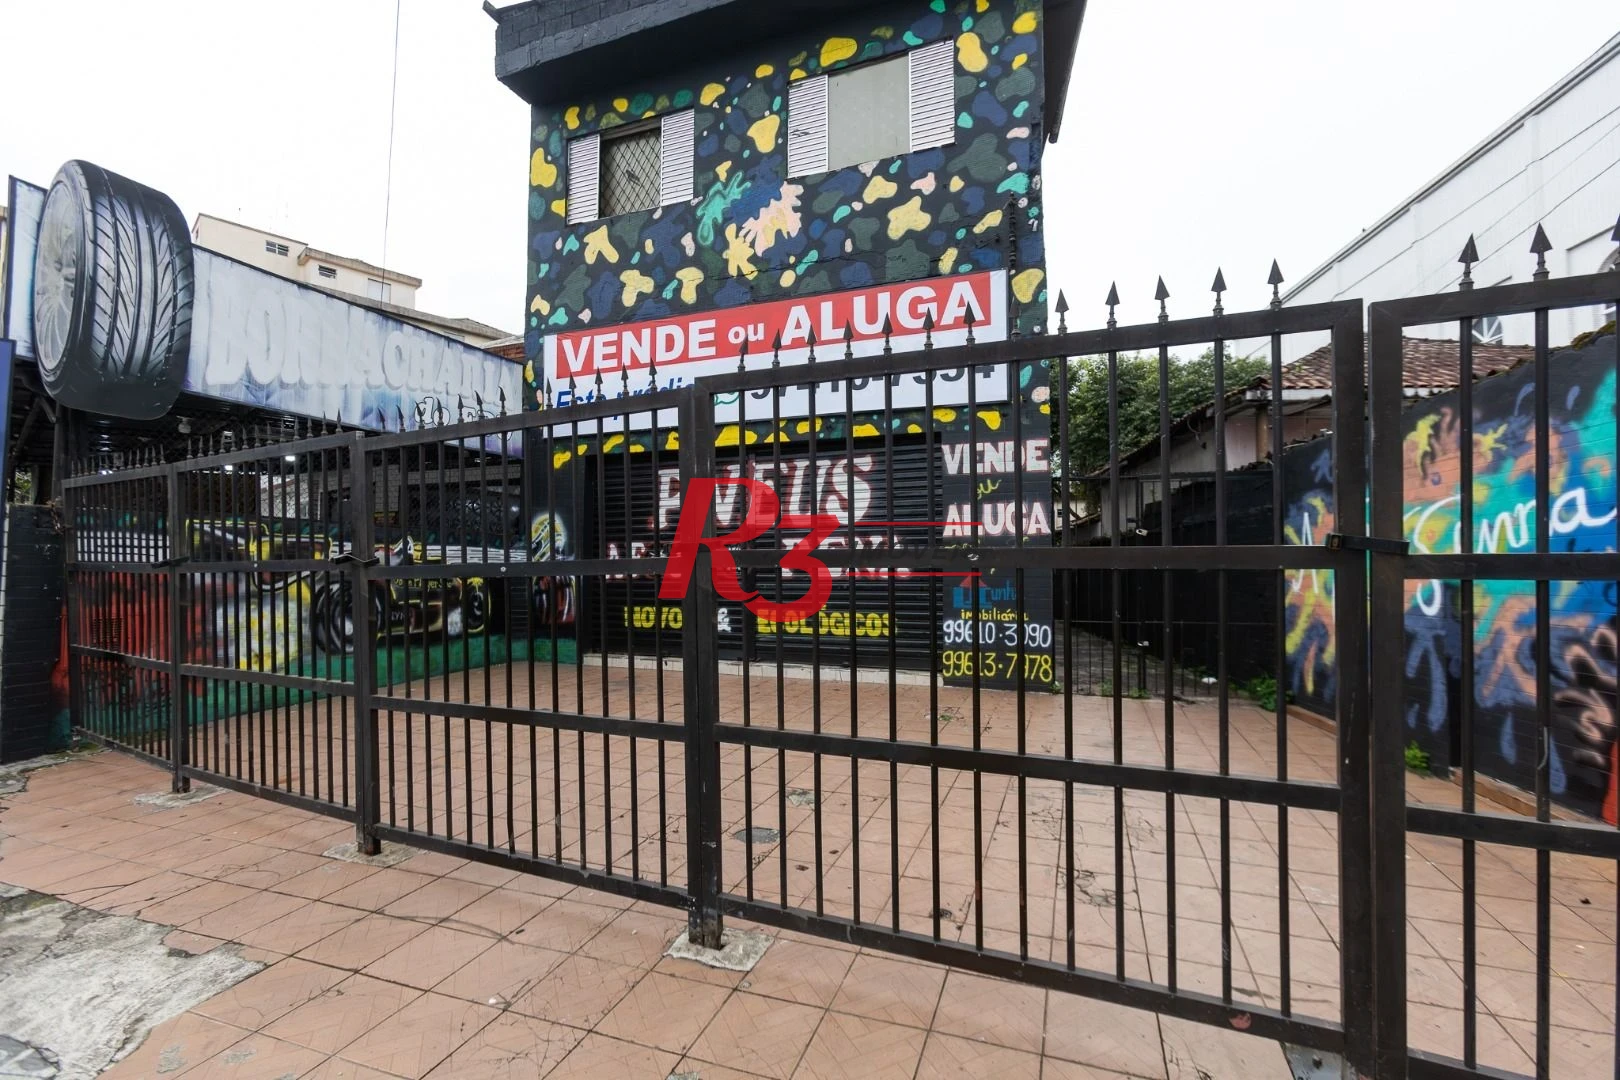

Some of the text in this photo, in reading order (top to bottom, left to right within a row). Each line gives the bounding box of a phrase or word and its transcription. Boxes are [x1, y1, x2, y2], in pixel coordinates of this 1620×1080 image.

[561, 280, 985, 373] VENDE ou ALUGA
[941, 439, 1049, 475] VENDE
[942, 501, 1052, 536] ALUGA
